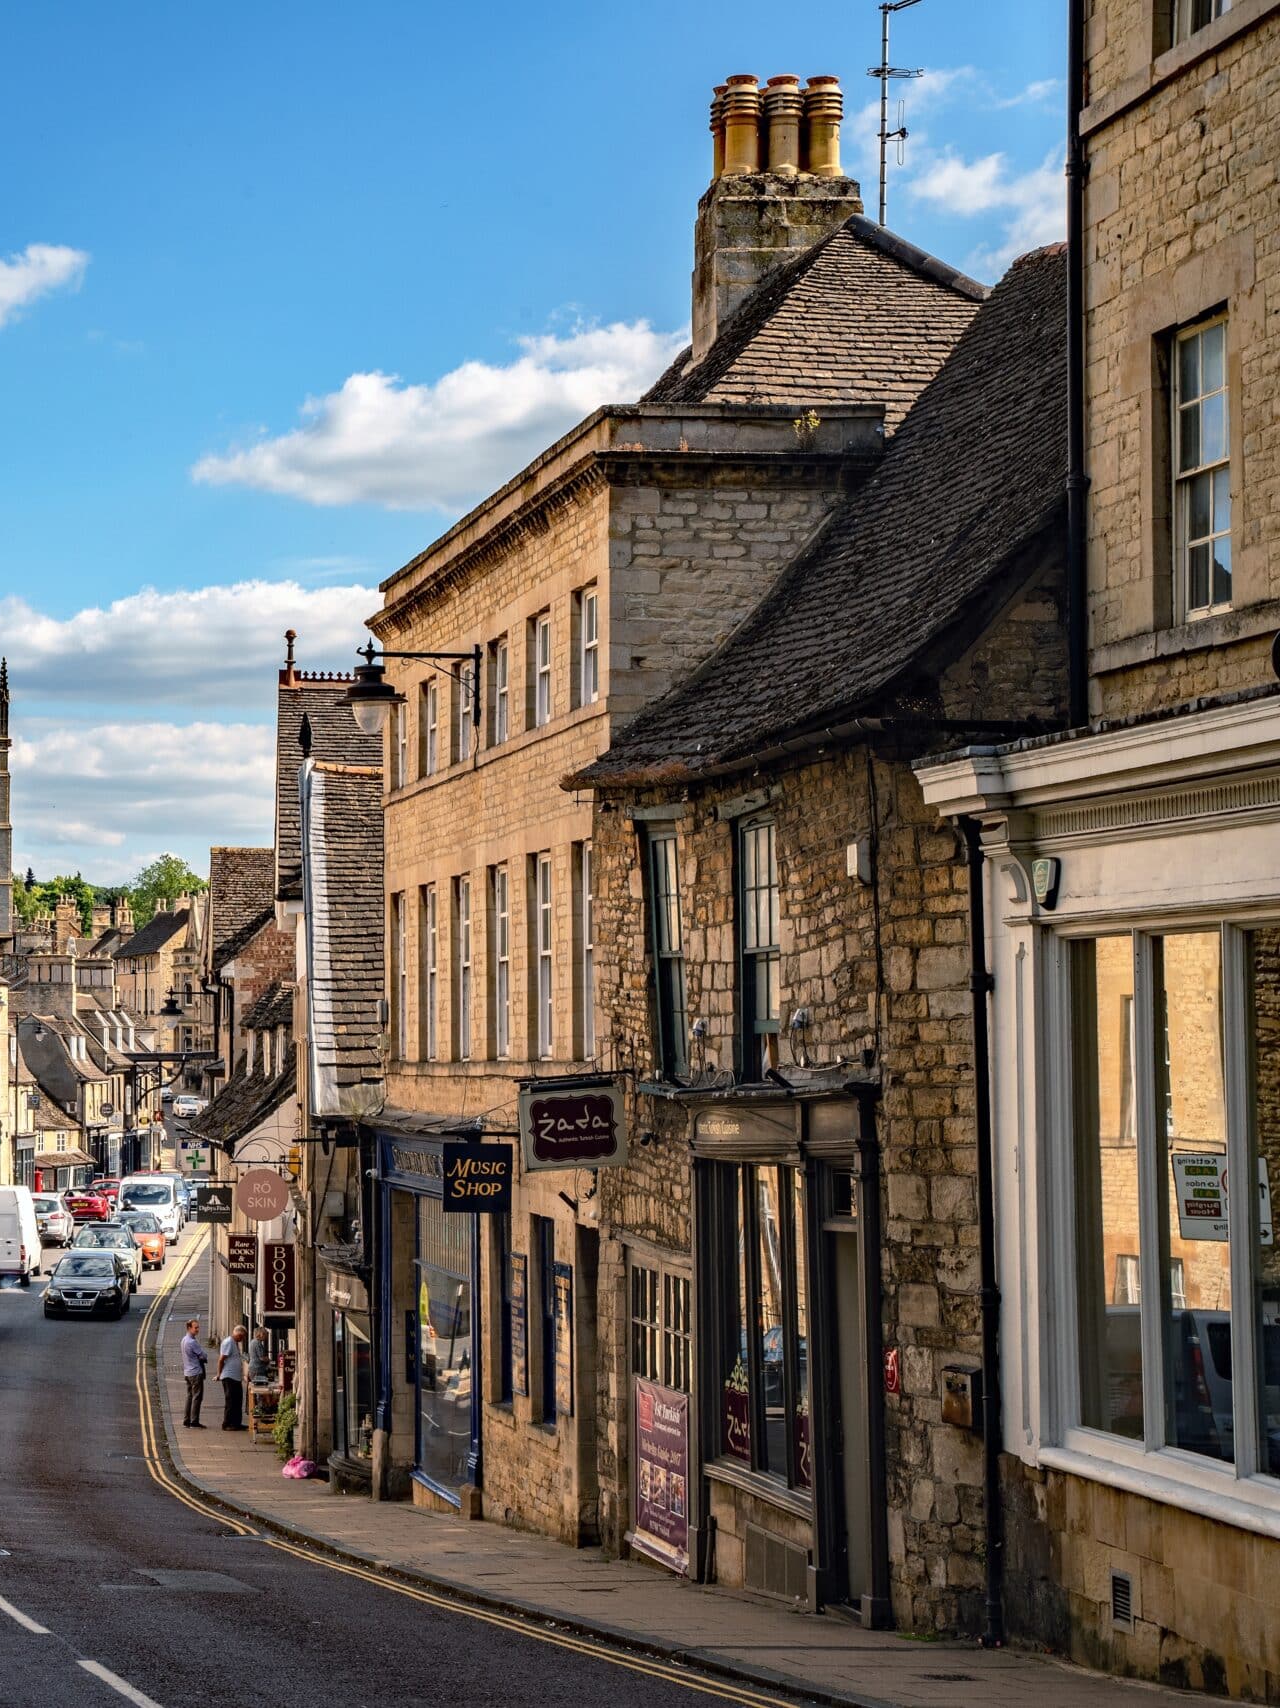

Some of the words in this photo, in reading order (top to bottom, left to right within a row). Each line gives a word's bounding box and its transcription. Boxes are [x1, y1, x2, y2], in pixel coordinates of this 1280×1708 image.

[447, 1158, 507, 1178] MUSIC
[253, 1180, 272, 1194] RÖ
[451, 1179, 503, 1198] SHOP
[247, 1196, 277, 1209] SKIN
[272, 1246, 287, 1309] BOOKS
